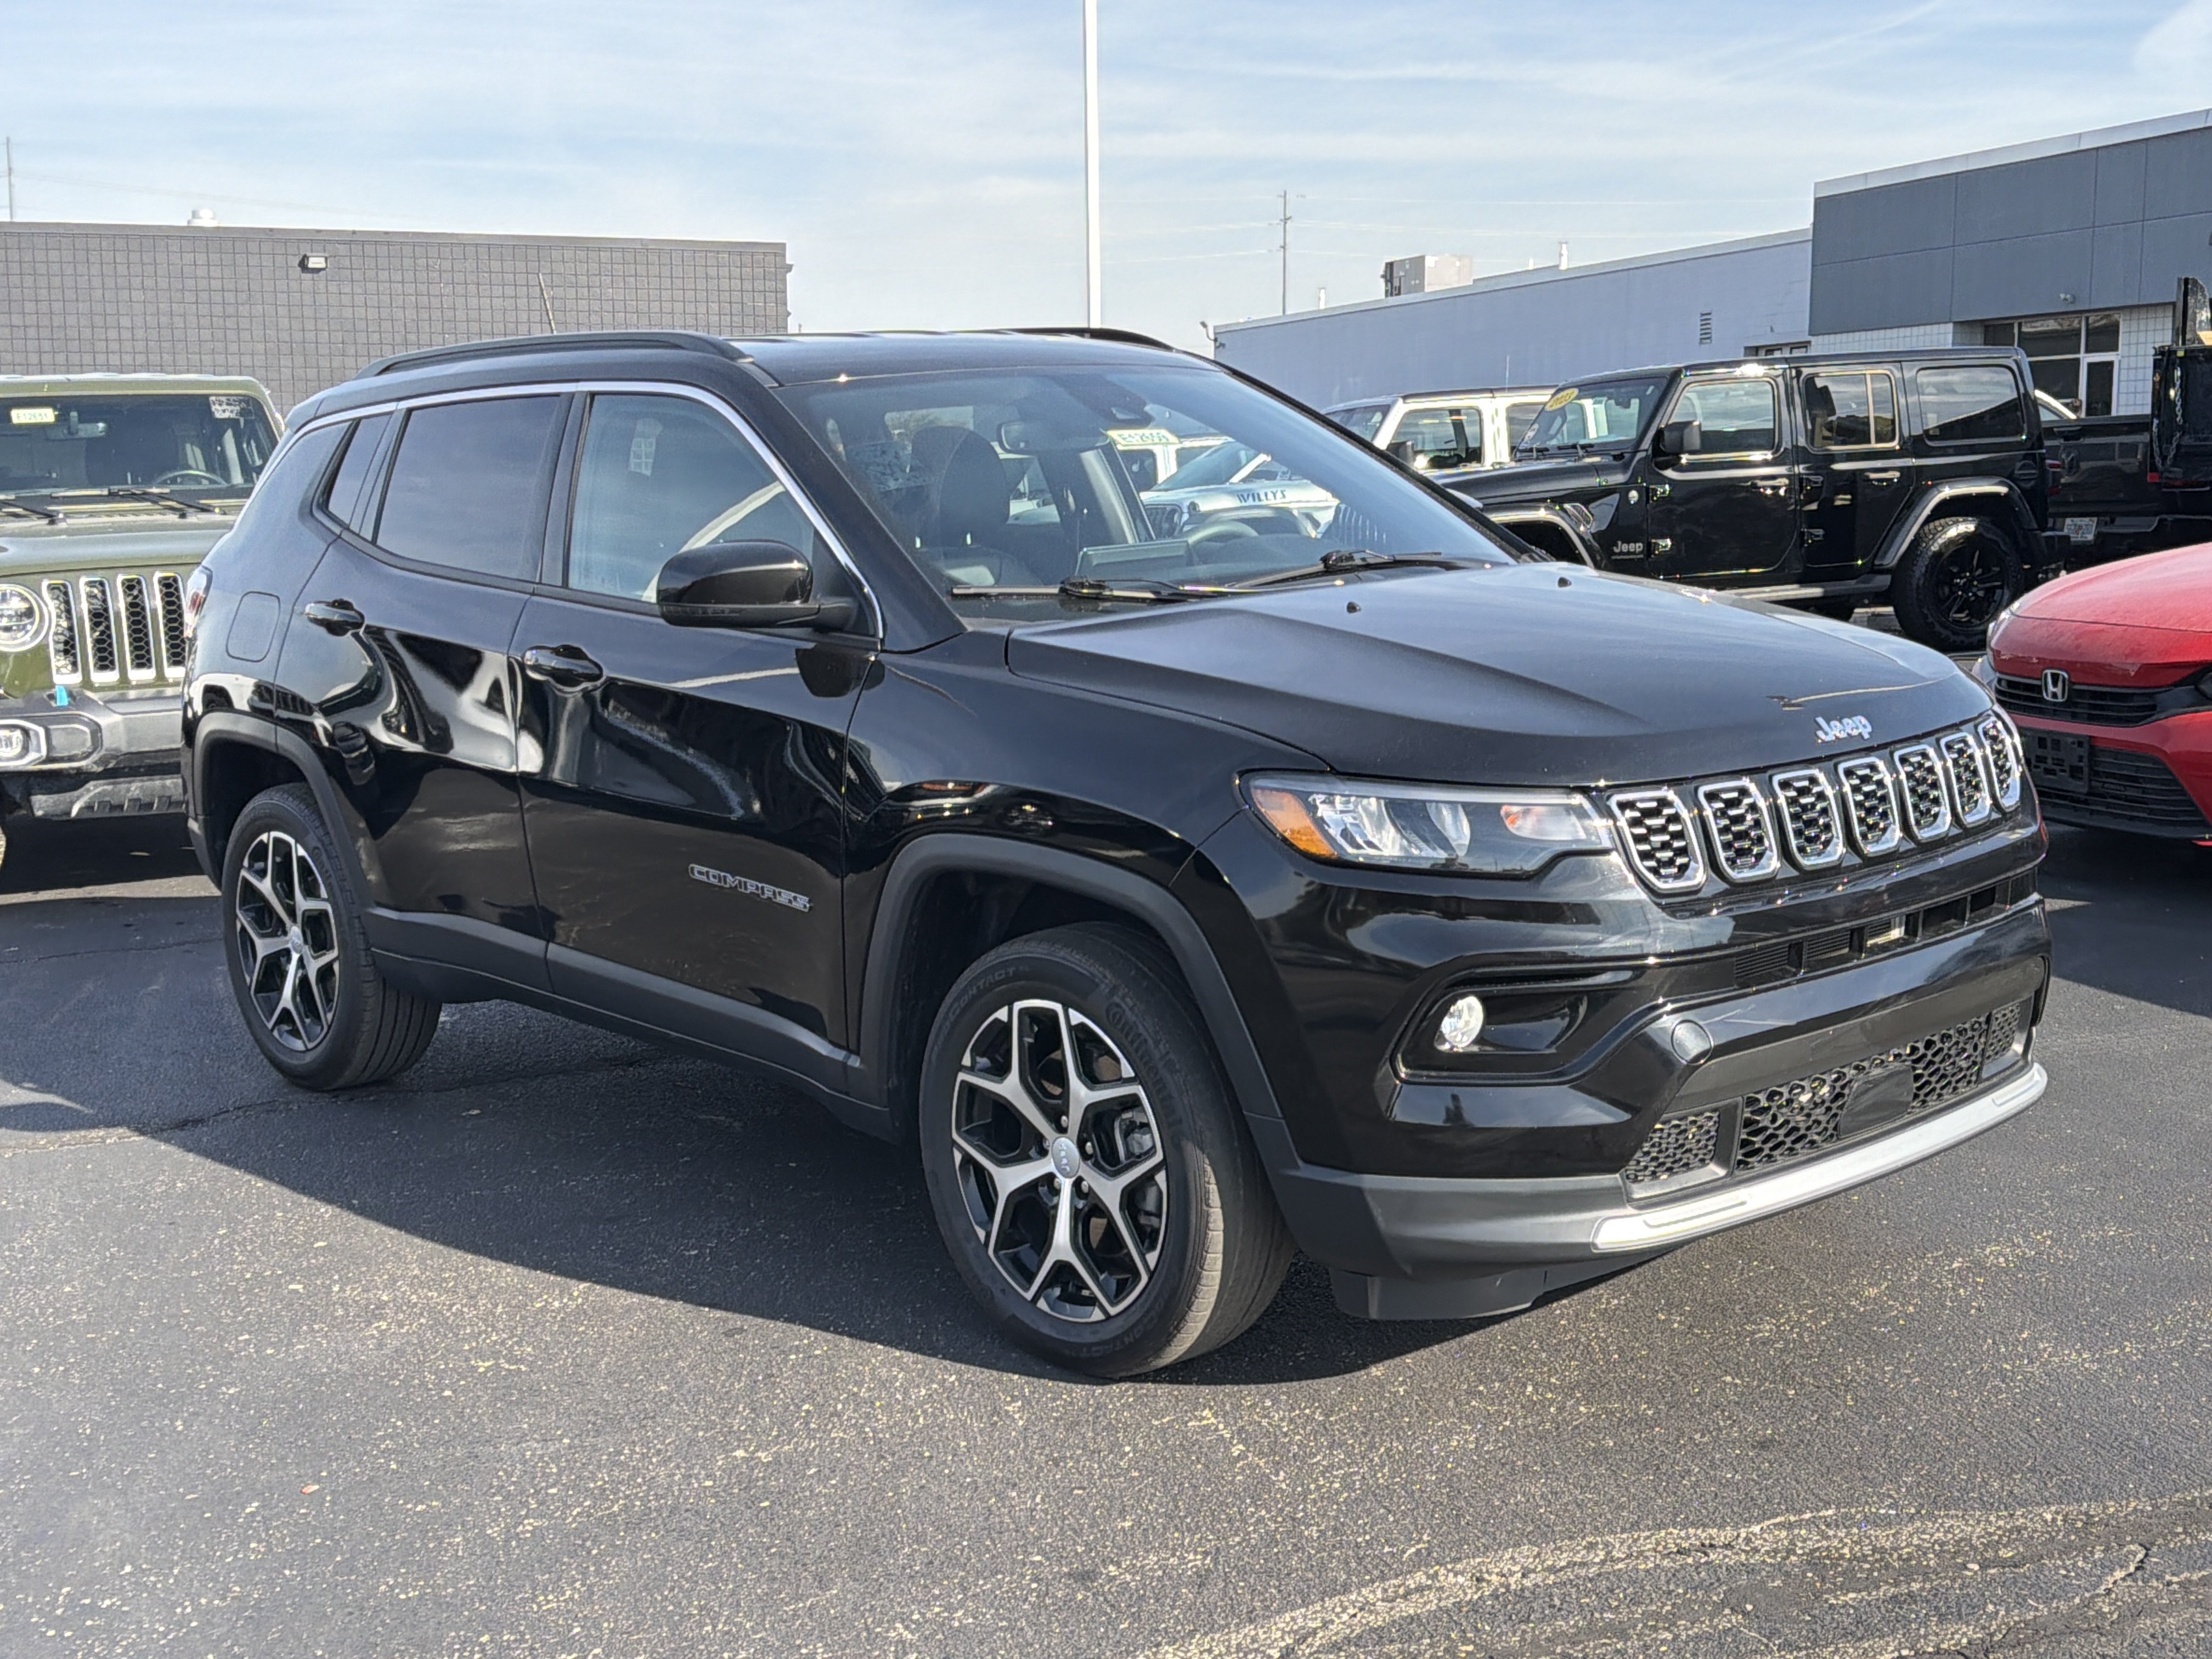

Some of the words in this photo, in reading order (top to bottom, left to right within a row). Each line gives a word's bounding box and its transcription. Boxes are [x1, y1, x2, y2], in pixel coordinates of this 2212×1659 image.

[1236, 489, 1286, 504] WILLYS
[1612, 540, 1644, 554] Jeep
[1815, 715, 1872, 742] Jeep
[689, 864, 811, 912] COMPASS
